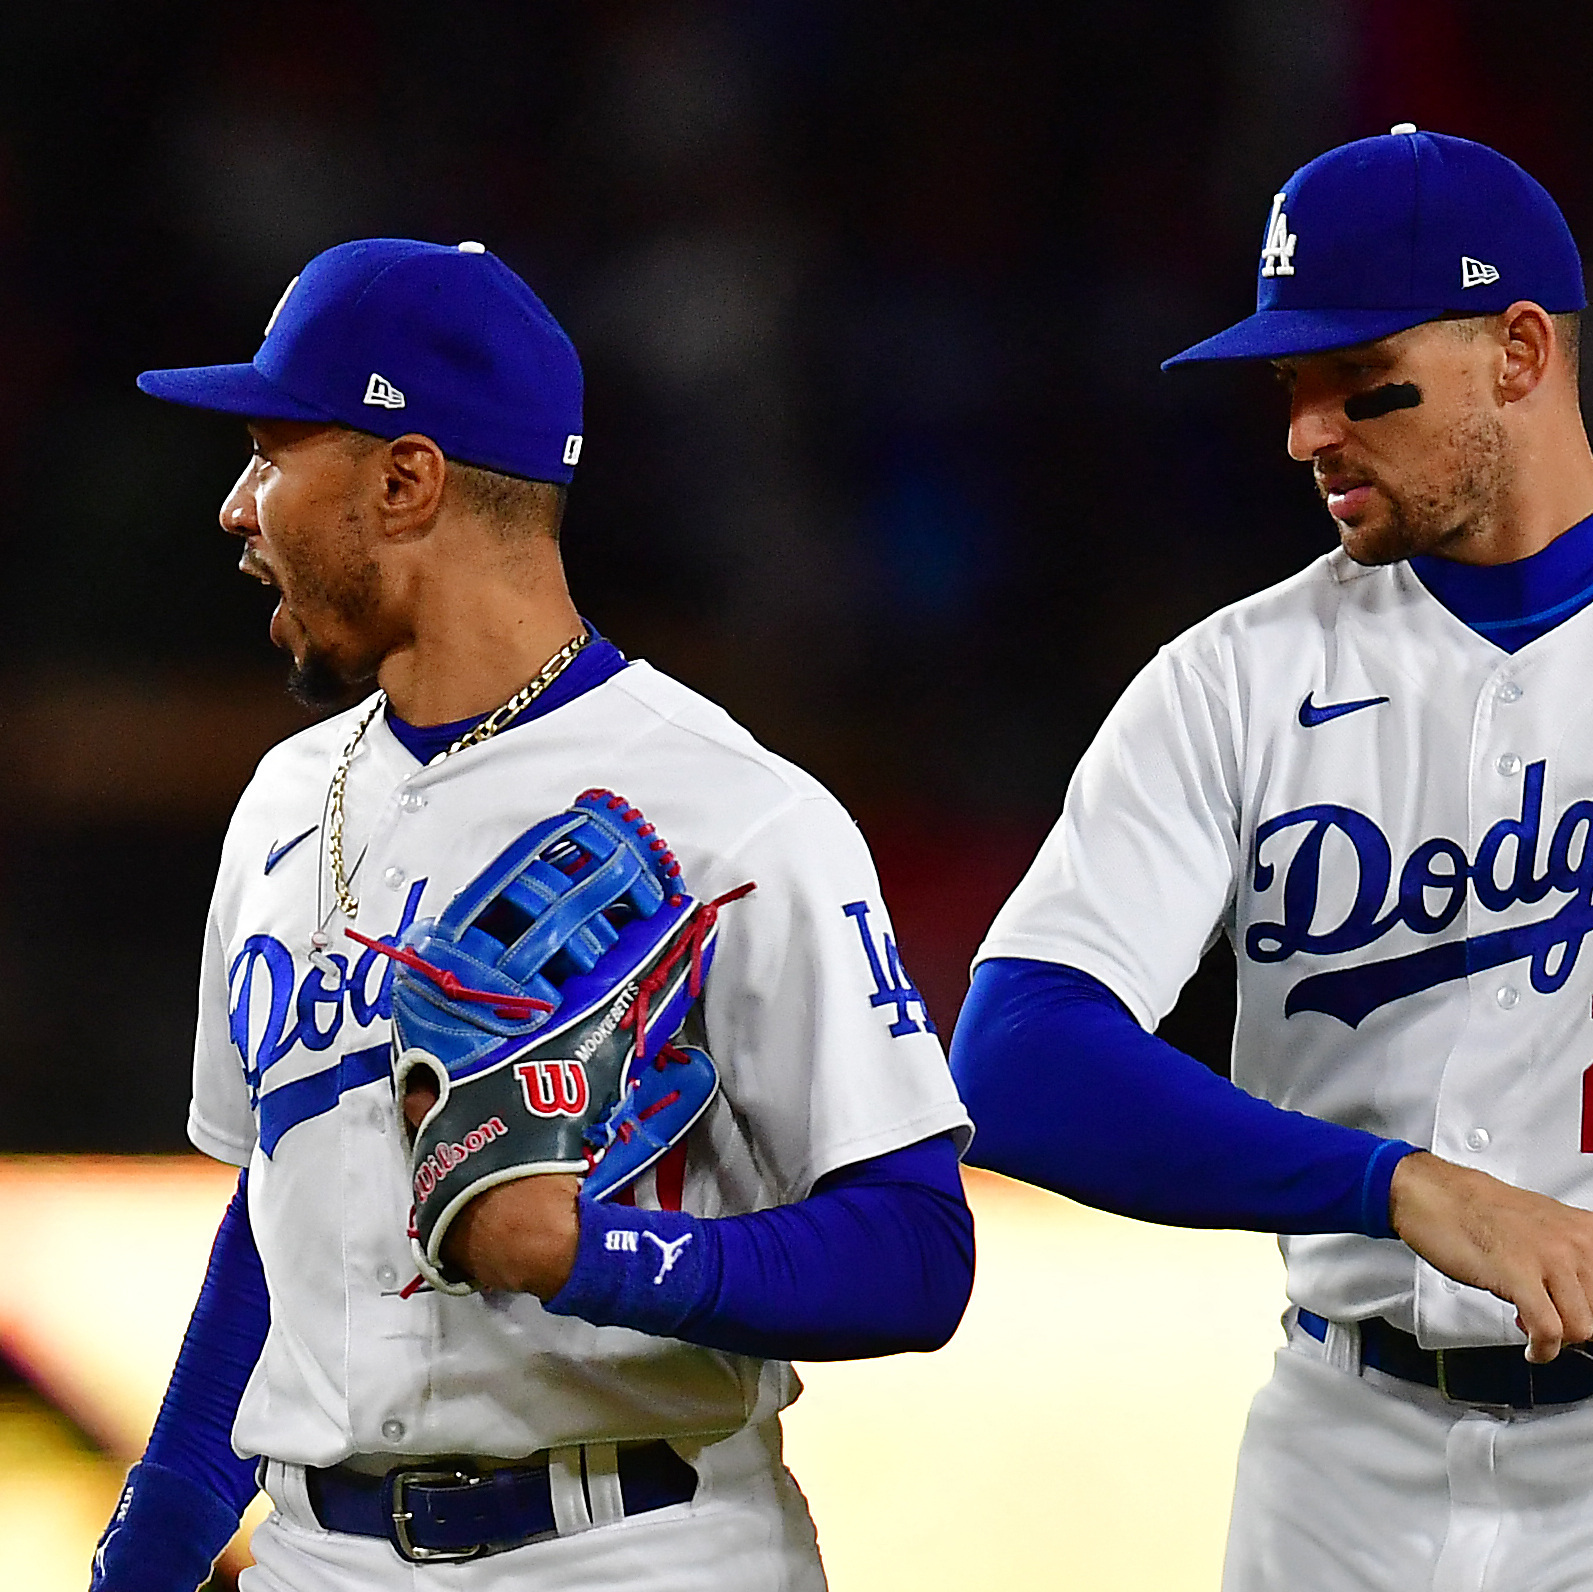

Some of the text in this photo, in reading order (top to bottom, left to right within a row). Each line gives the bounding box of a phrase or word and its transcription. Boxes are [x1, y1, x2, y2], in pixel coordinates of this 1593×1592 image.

[1261, 192, 1298, 278] LA
[228, 876, 429, 1108] Dod
[414, 1116, 508, 1202] Wilson
